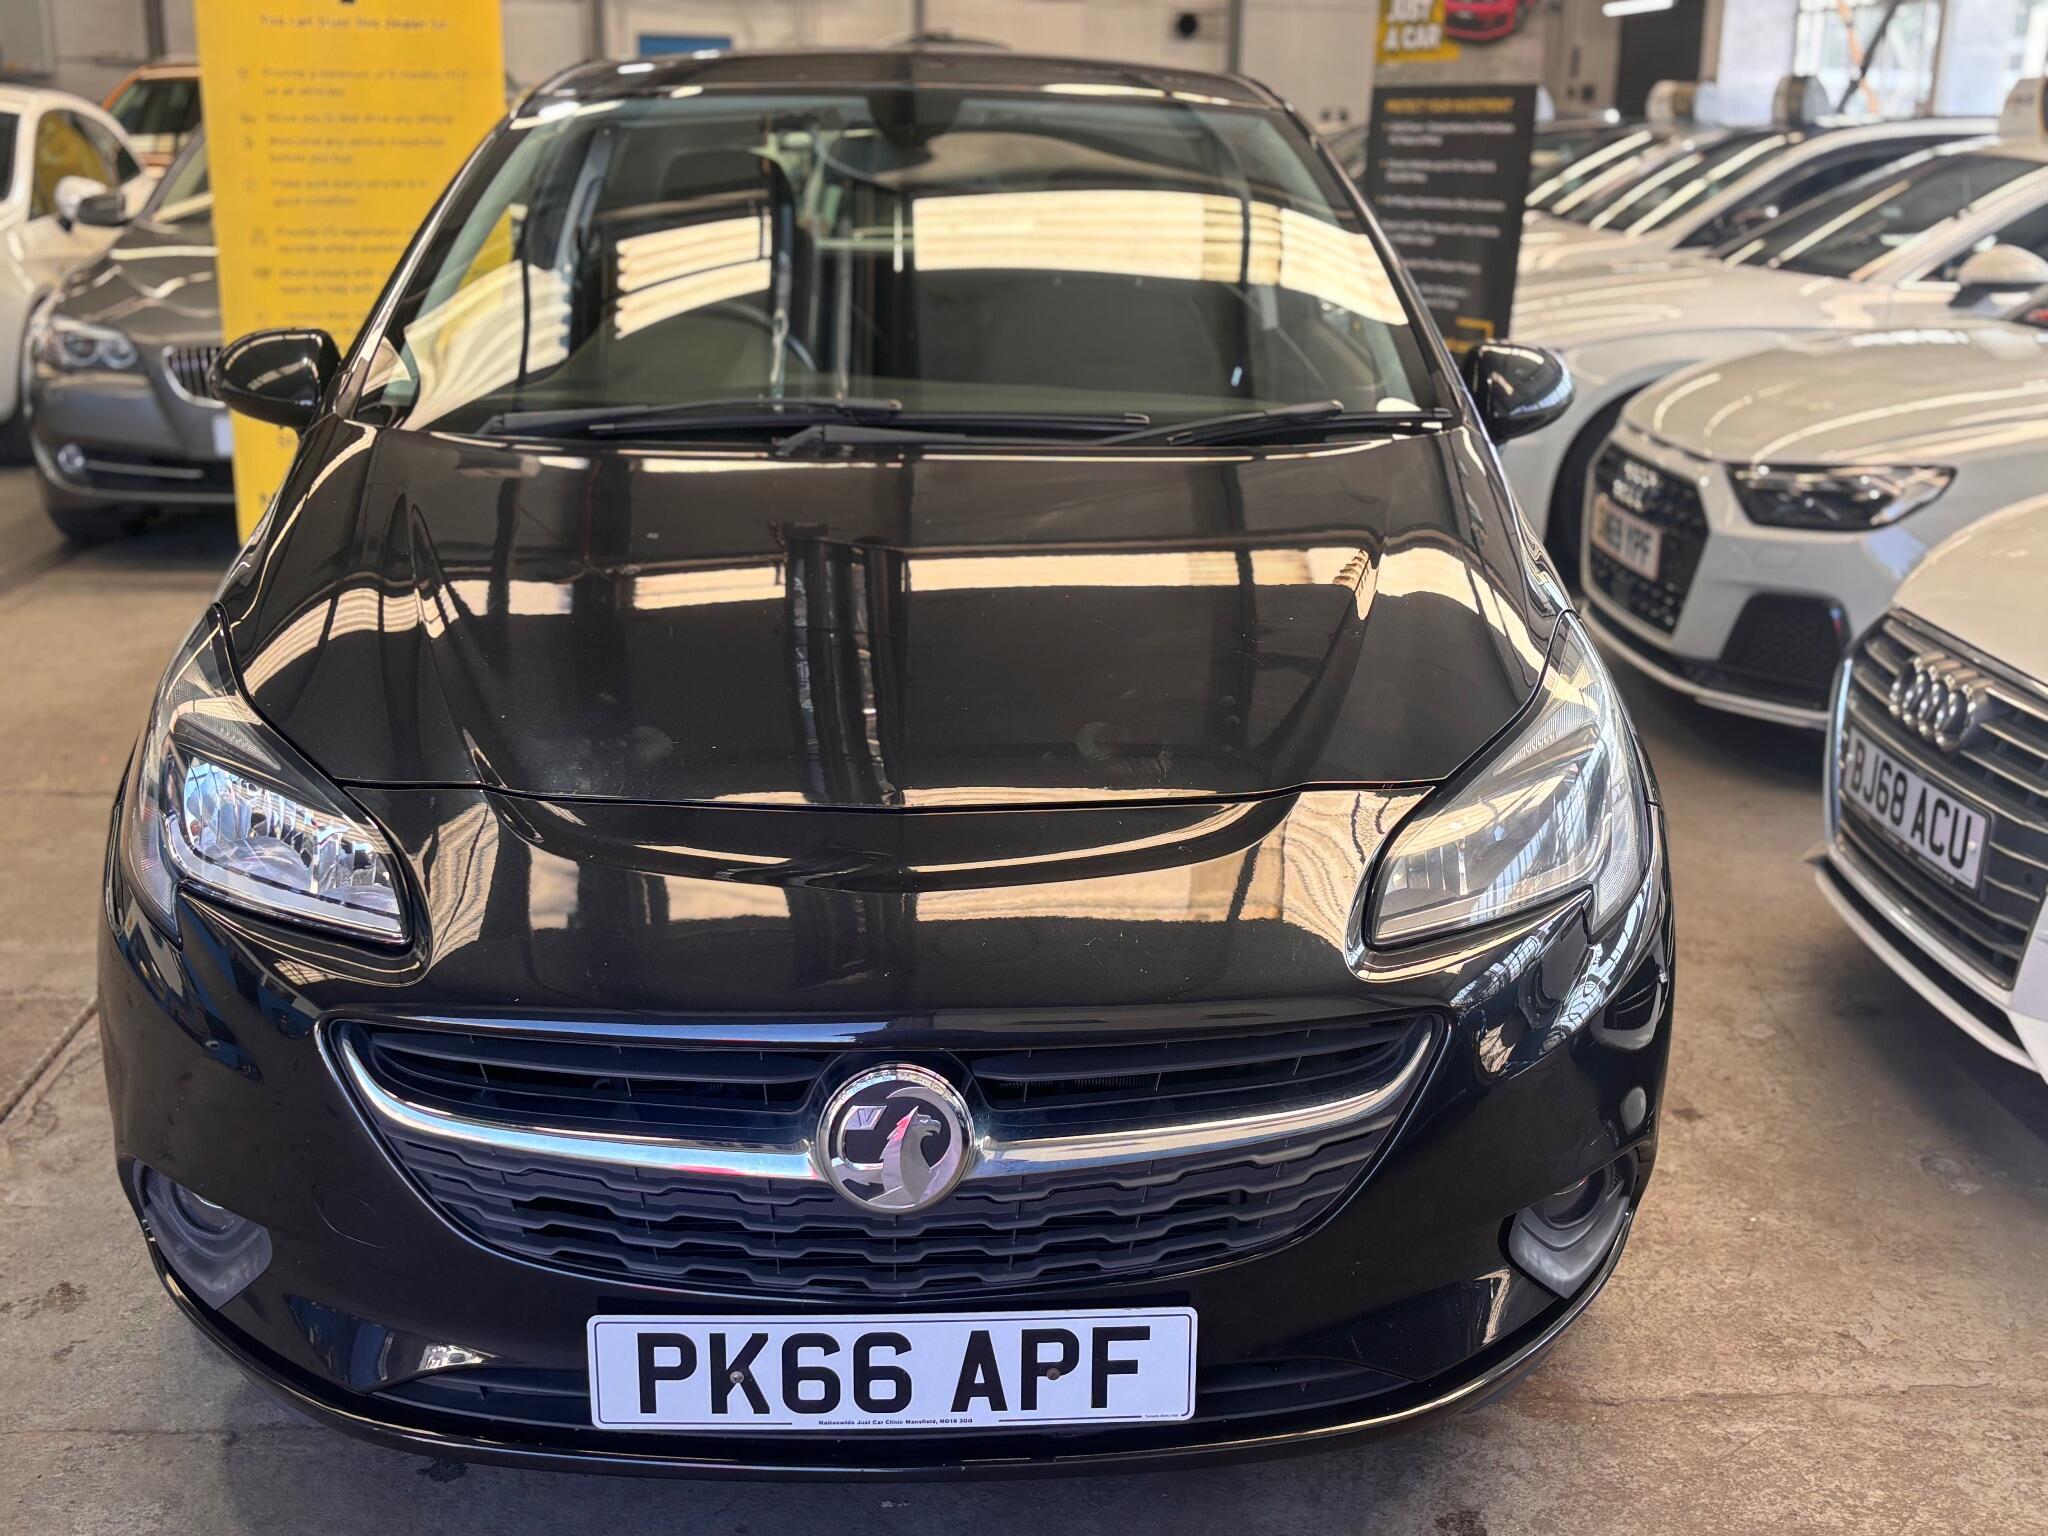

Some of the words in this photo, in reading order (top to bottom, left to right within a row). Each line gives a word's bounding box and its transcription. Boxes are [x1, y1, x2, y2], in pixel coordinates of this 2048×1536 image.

[1402, 23, 1442, 49] CAR
[1850, 740, 1908, 826] BJ68
[1911, 786, 1972, 870] ACU
[636, 1332, 912, 1415] PK66
[950, 1325, 1151, 1413] APF
